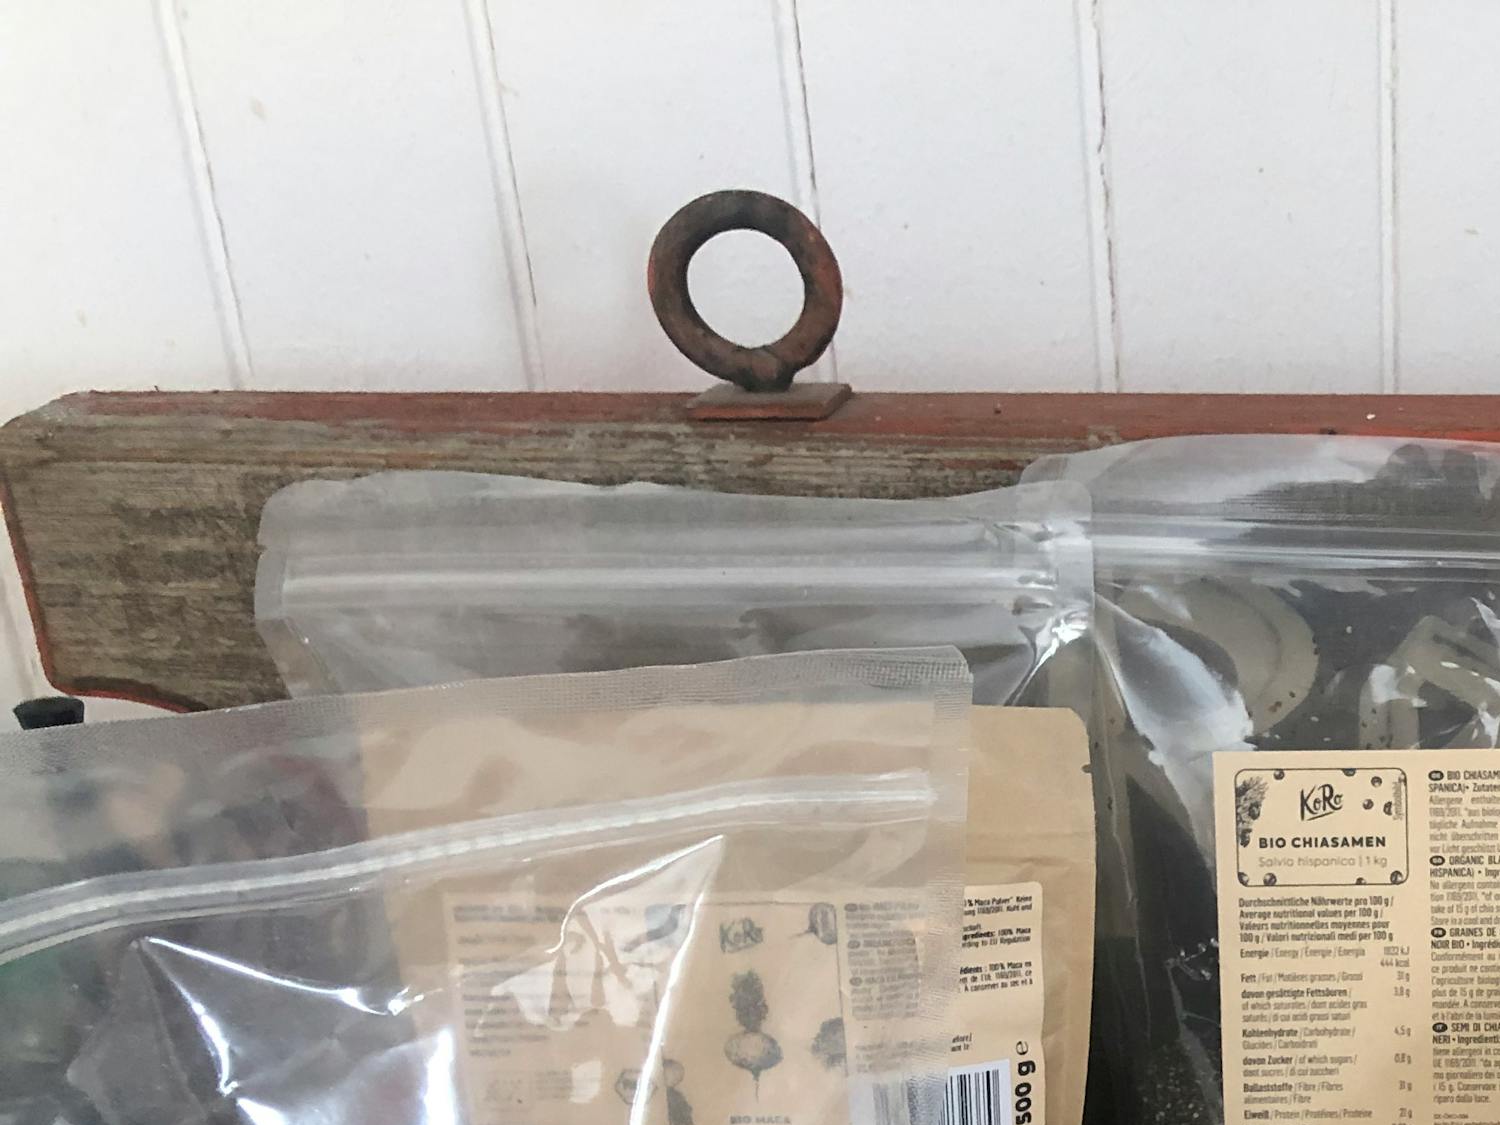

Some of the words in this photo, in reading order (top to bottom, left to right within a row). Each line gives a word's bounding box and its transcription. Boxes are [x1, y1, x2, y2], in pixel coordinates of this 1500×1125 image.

[1299, 783, 1343, 821] KoRo
[1258, 837, 1286, 850] BIO
[1291, 835, 1387, 850] CHIASAMEN
[1258, 855, 1294, 868] Salvia
[1297, 854, 1356, 869] hispanica
[1366, 855, 1371, 868] 1
[1372, 854, 1388, 870] kg
[1020, 1060, 1036, 1077] g
[1015, 1082, 1032, 1125] 500
